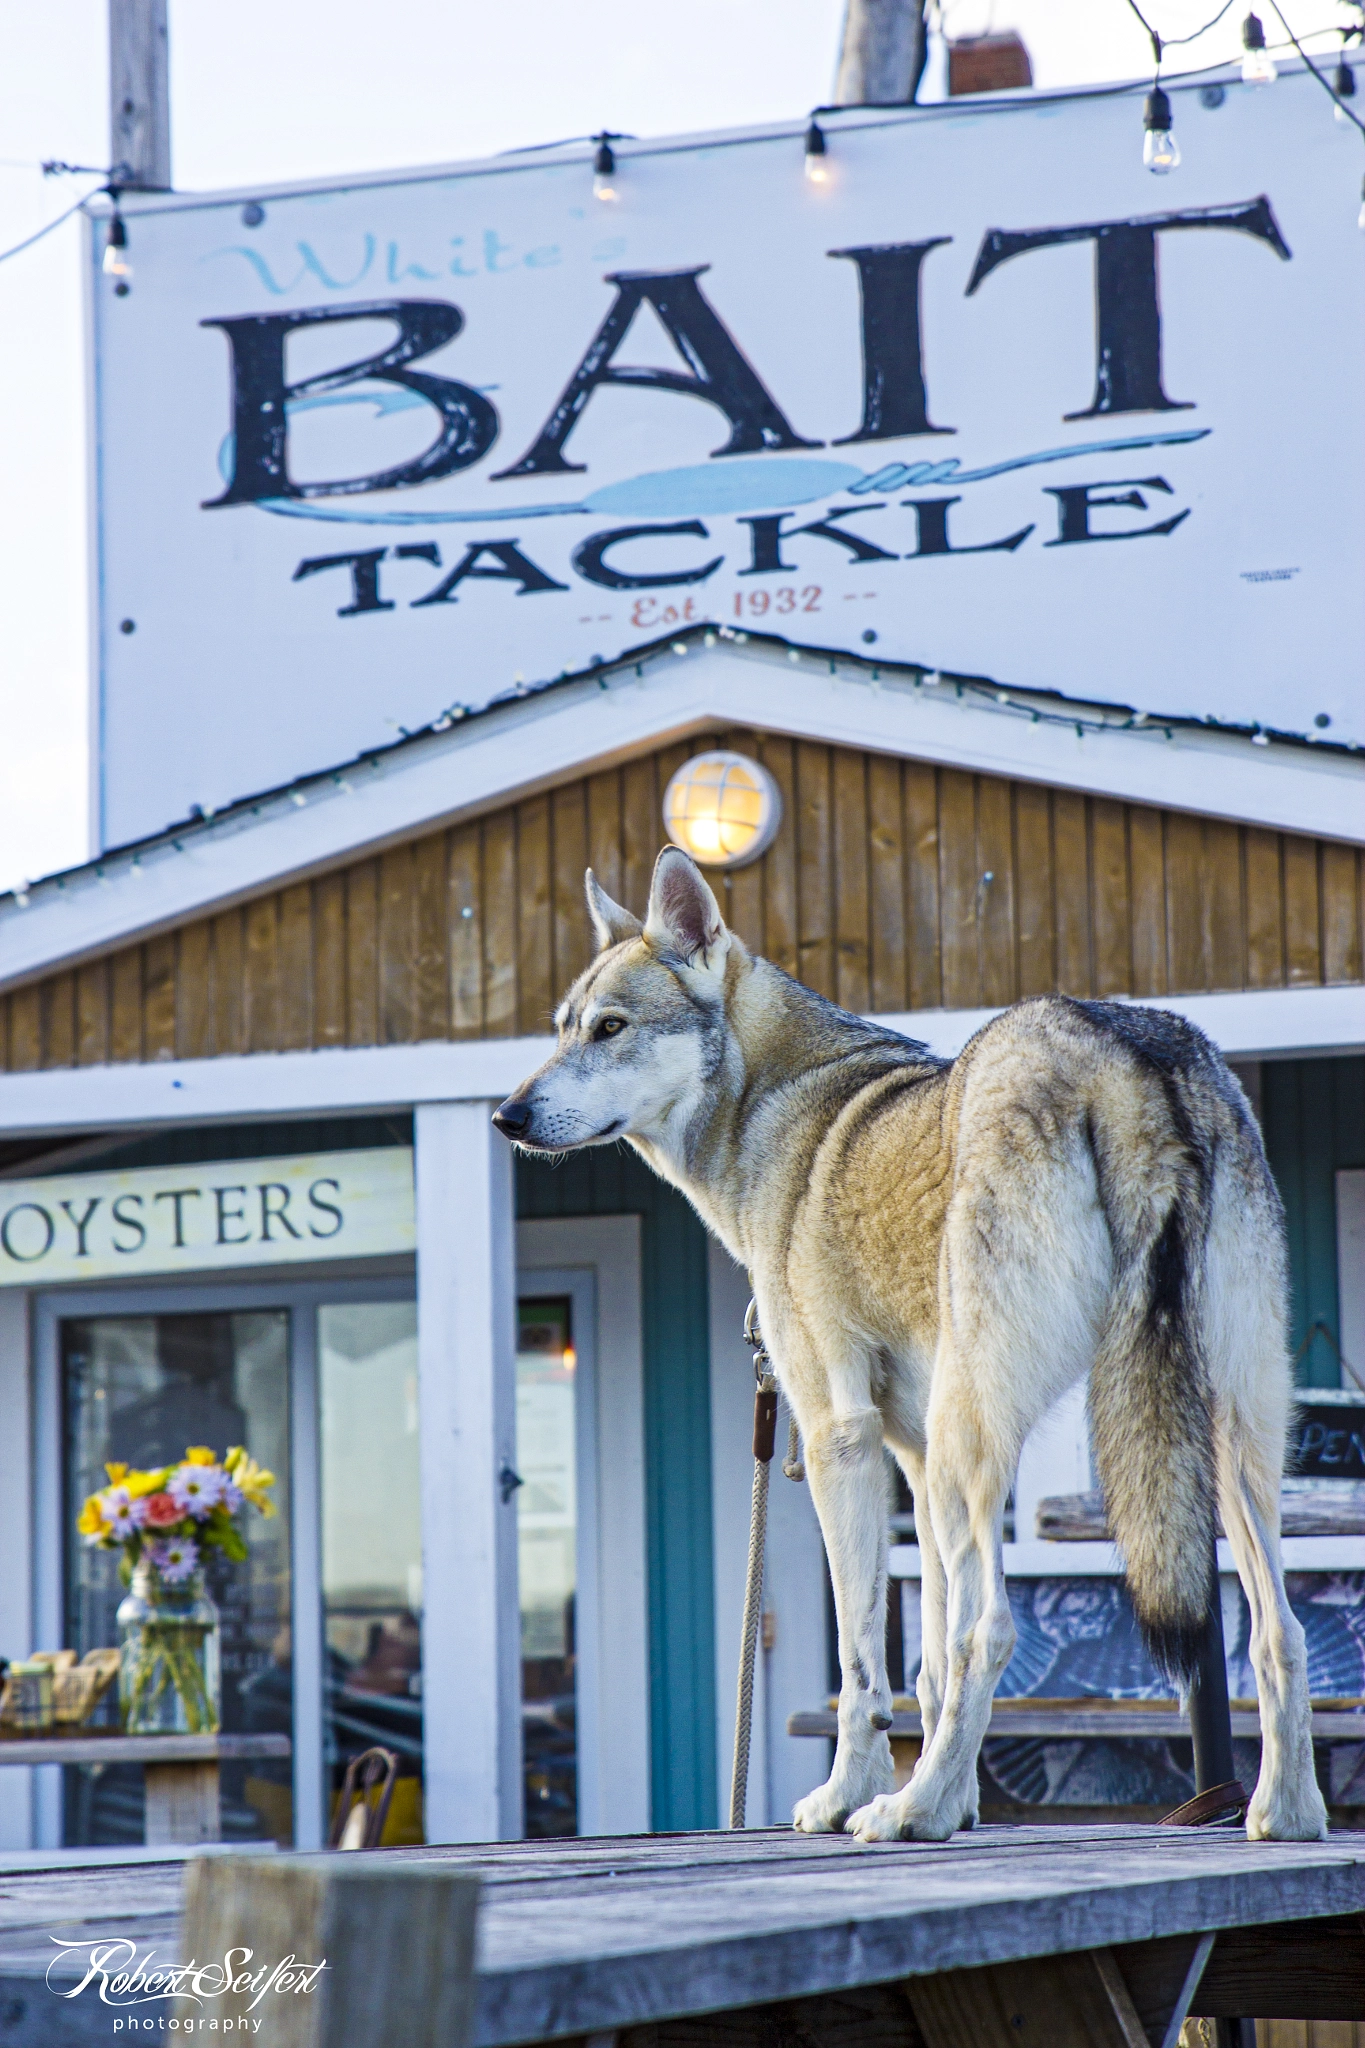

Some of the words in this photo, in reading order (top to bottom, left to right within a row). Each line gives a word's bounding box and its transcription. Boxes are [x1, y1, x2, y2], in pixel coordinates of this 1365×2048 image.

[199, 194, 1292, 511] BAIT
[292, 478, 1192, 619] TACKLE
[630, 596, 710, 628] Est.
[733, 585, 824, 618] 1932
[0, 1178, 343, 1263] OYSTERS
[1297, 1421, 1365, 1465] PEN
